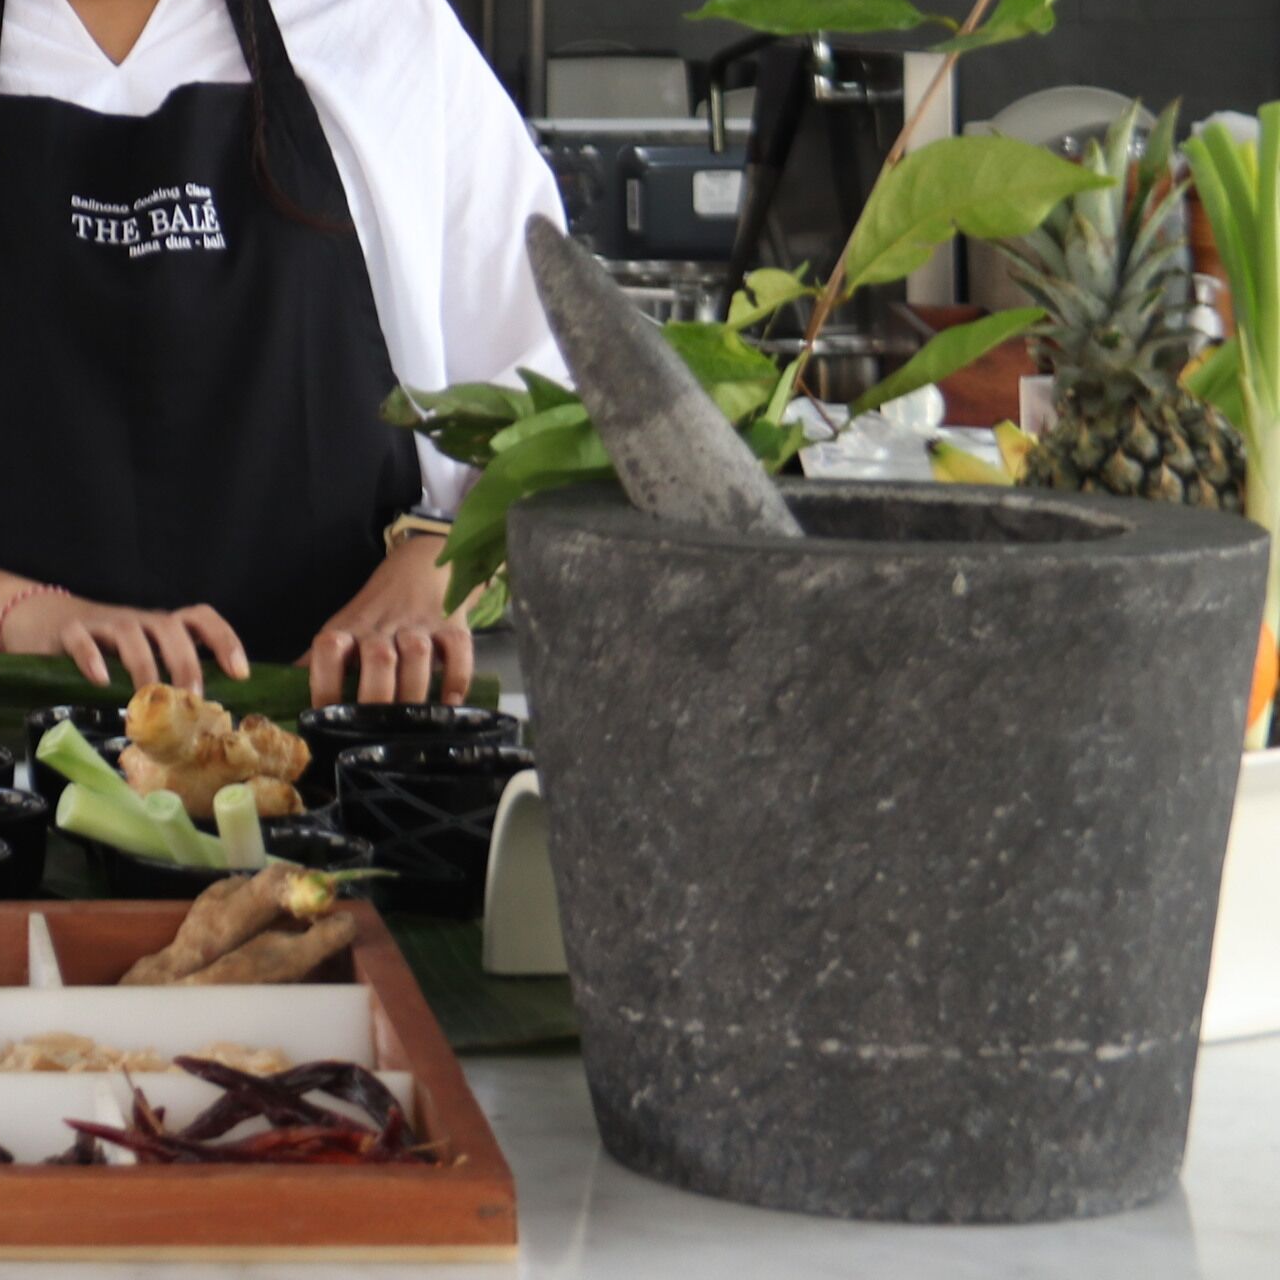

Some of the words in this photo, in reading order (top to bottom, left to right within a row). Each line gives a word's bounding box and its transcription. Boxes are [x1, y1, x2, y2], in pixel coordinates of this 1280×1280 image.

[133, 186, 180, 211] Cooking
[71, 213, 140, 244] THE
[148, 198, 221, 237] BALÉ
[165, 234, 192, 250] dua
[203, 232, 227, 250] bali
